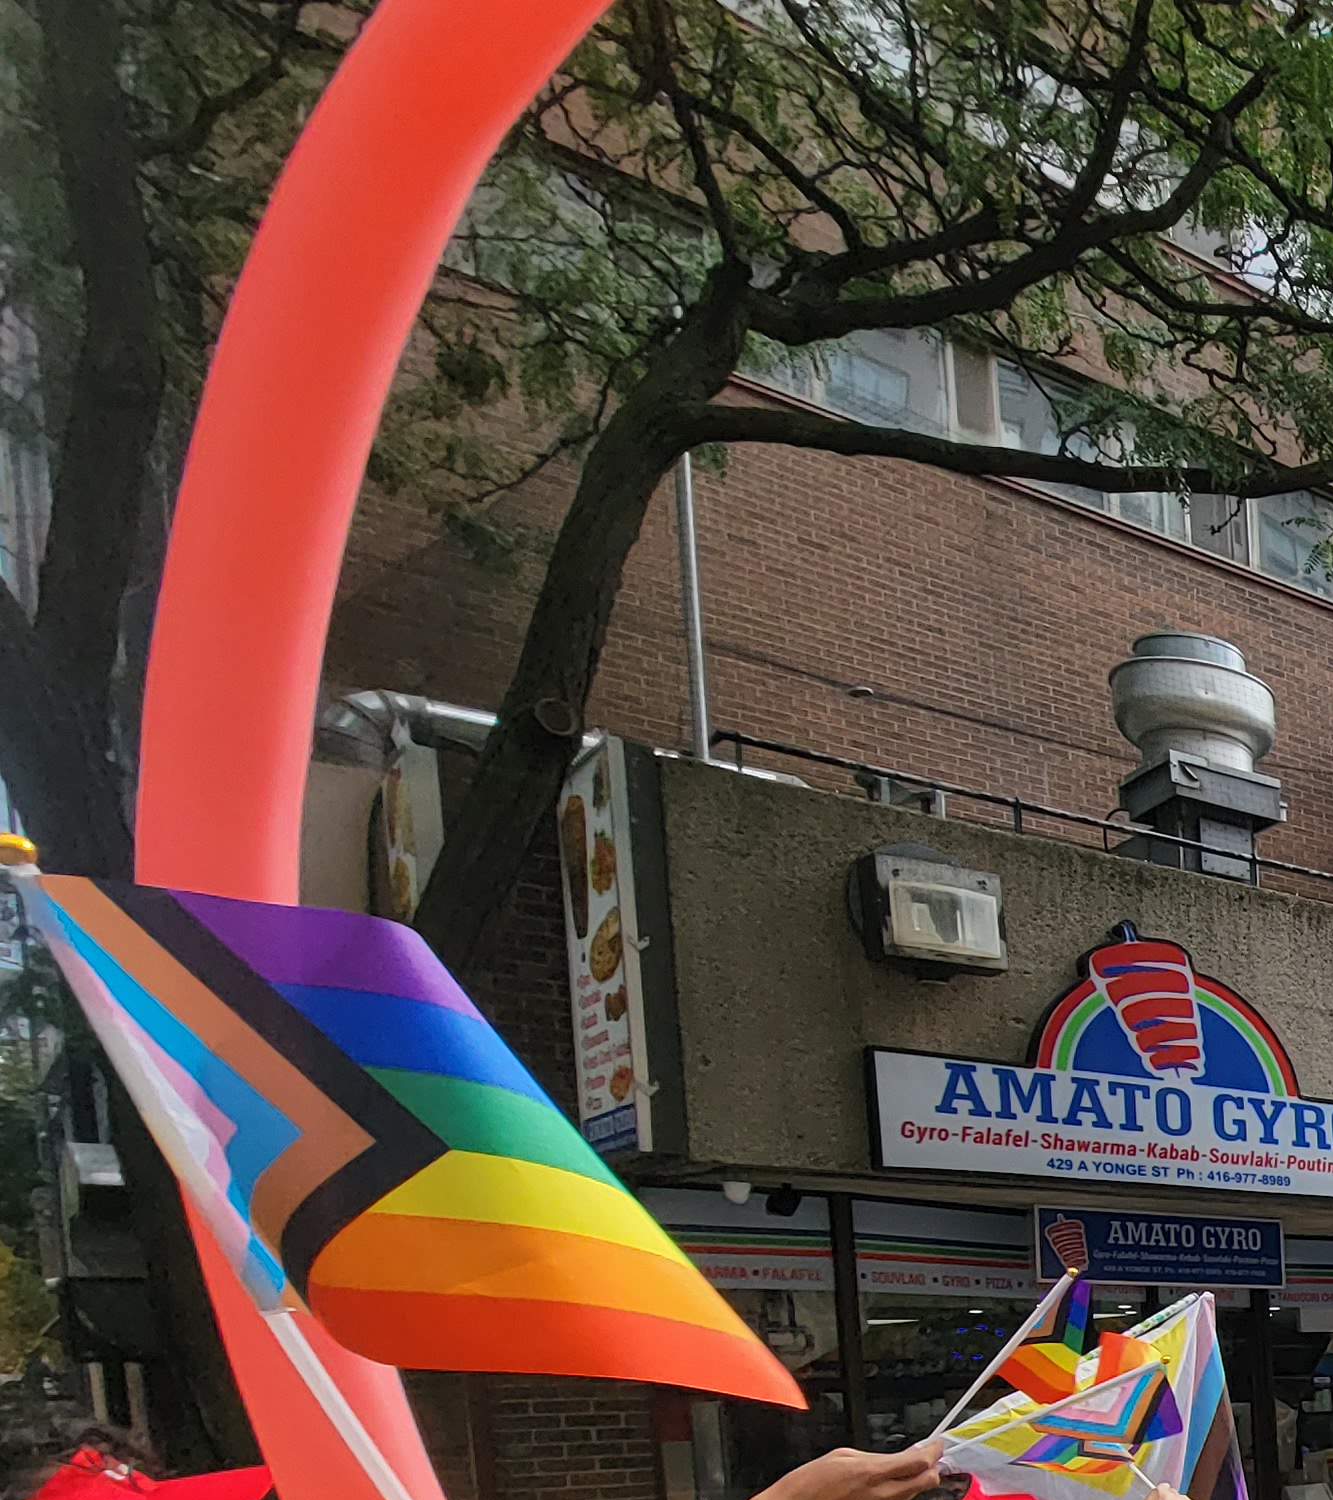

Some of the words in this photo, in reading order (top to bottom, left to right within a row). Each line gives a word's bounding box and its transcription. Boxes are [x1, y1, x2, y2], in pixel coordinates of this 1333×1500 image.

[935, 1062, 1192, 1137] AMATO
[1046, 1157, 1073, 1171] 429
[1077, 1160, 1089, 1172] A
[1092, 1161, 1147, 1176] YONGE
[1151, 1165, 1170, 1178] ST
[1177, 1167, 1195, 1181] Ph
[1207, 1170, 1292, 1187] 416-977-8989
[1107, 1221, 1195, 1247] AMATO
[1202, 1226, 1262, 1250] GYRO
[704, 1266, 748, 1281] ARMA
[761, 1267, 823, 1282] FALAFEL
[871, 1271, 926, 1286] SOUVLAKI
[941, 1275, 971, 1288] GYRO
[985, 1277, 1013, 1289] PIZZA
